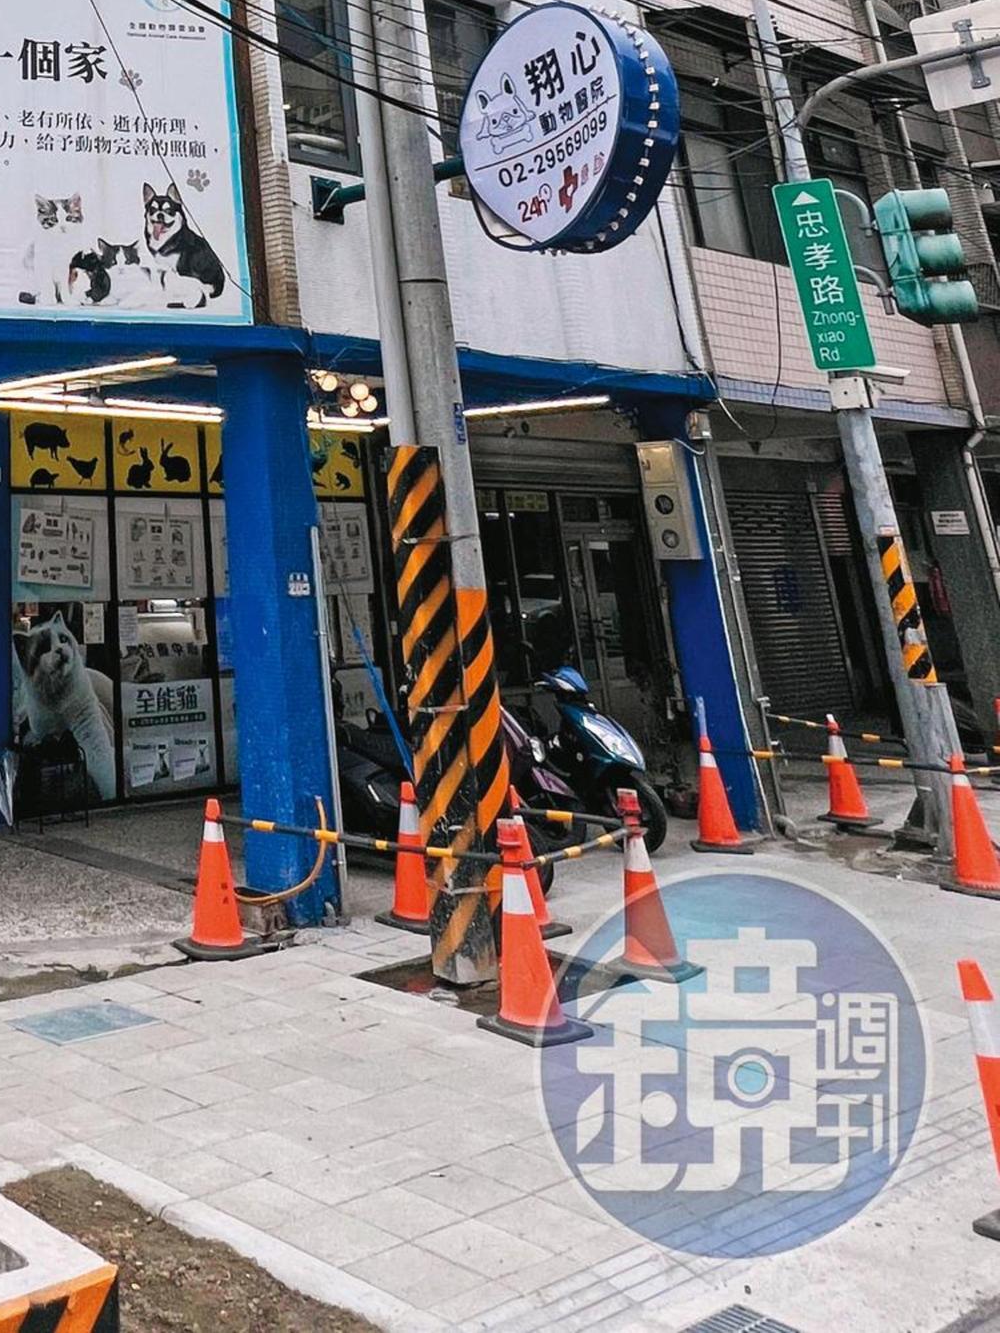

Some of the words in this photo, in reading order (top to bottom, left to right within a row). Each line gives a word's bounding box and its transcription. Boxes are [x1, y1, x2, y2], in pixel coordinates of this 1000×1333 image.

[524, 31, 601, 106] 翔心
[538, 77, 605, 136] 動物醫院
[498, 111, 608, 188] 02-29569099
[796, 210, 844, 306] 忠孝路
[812, 310, 860, 326] Zhong-
[817, 330, 845, 344] xiao
[136, 685, 198, 714] 全能貓
